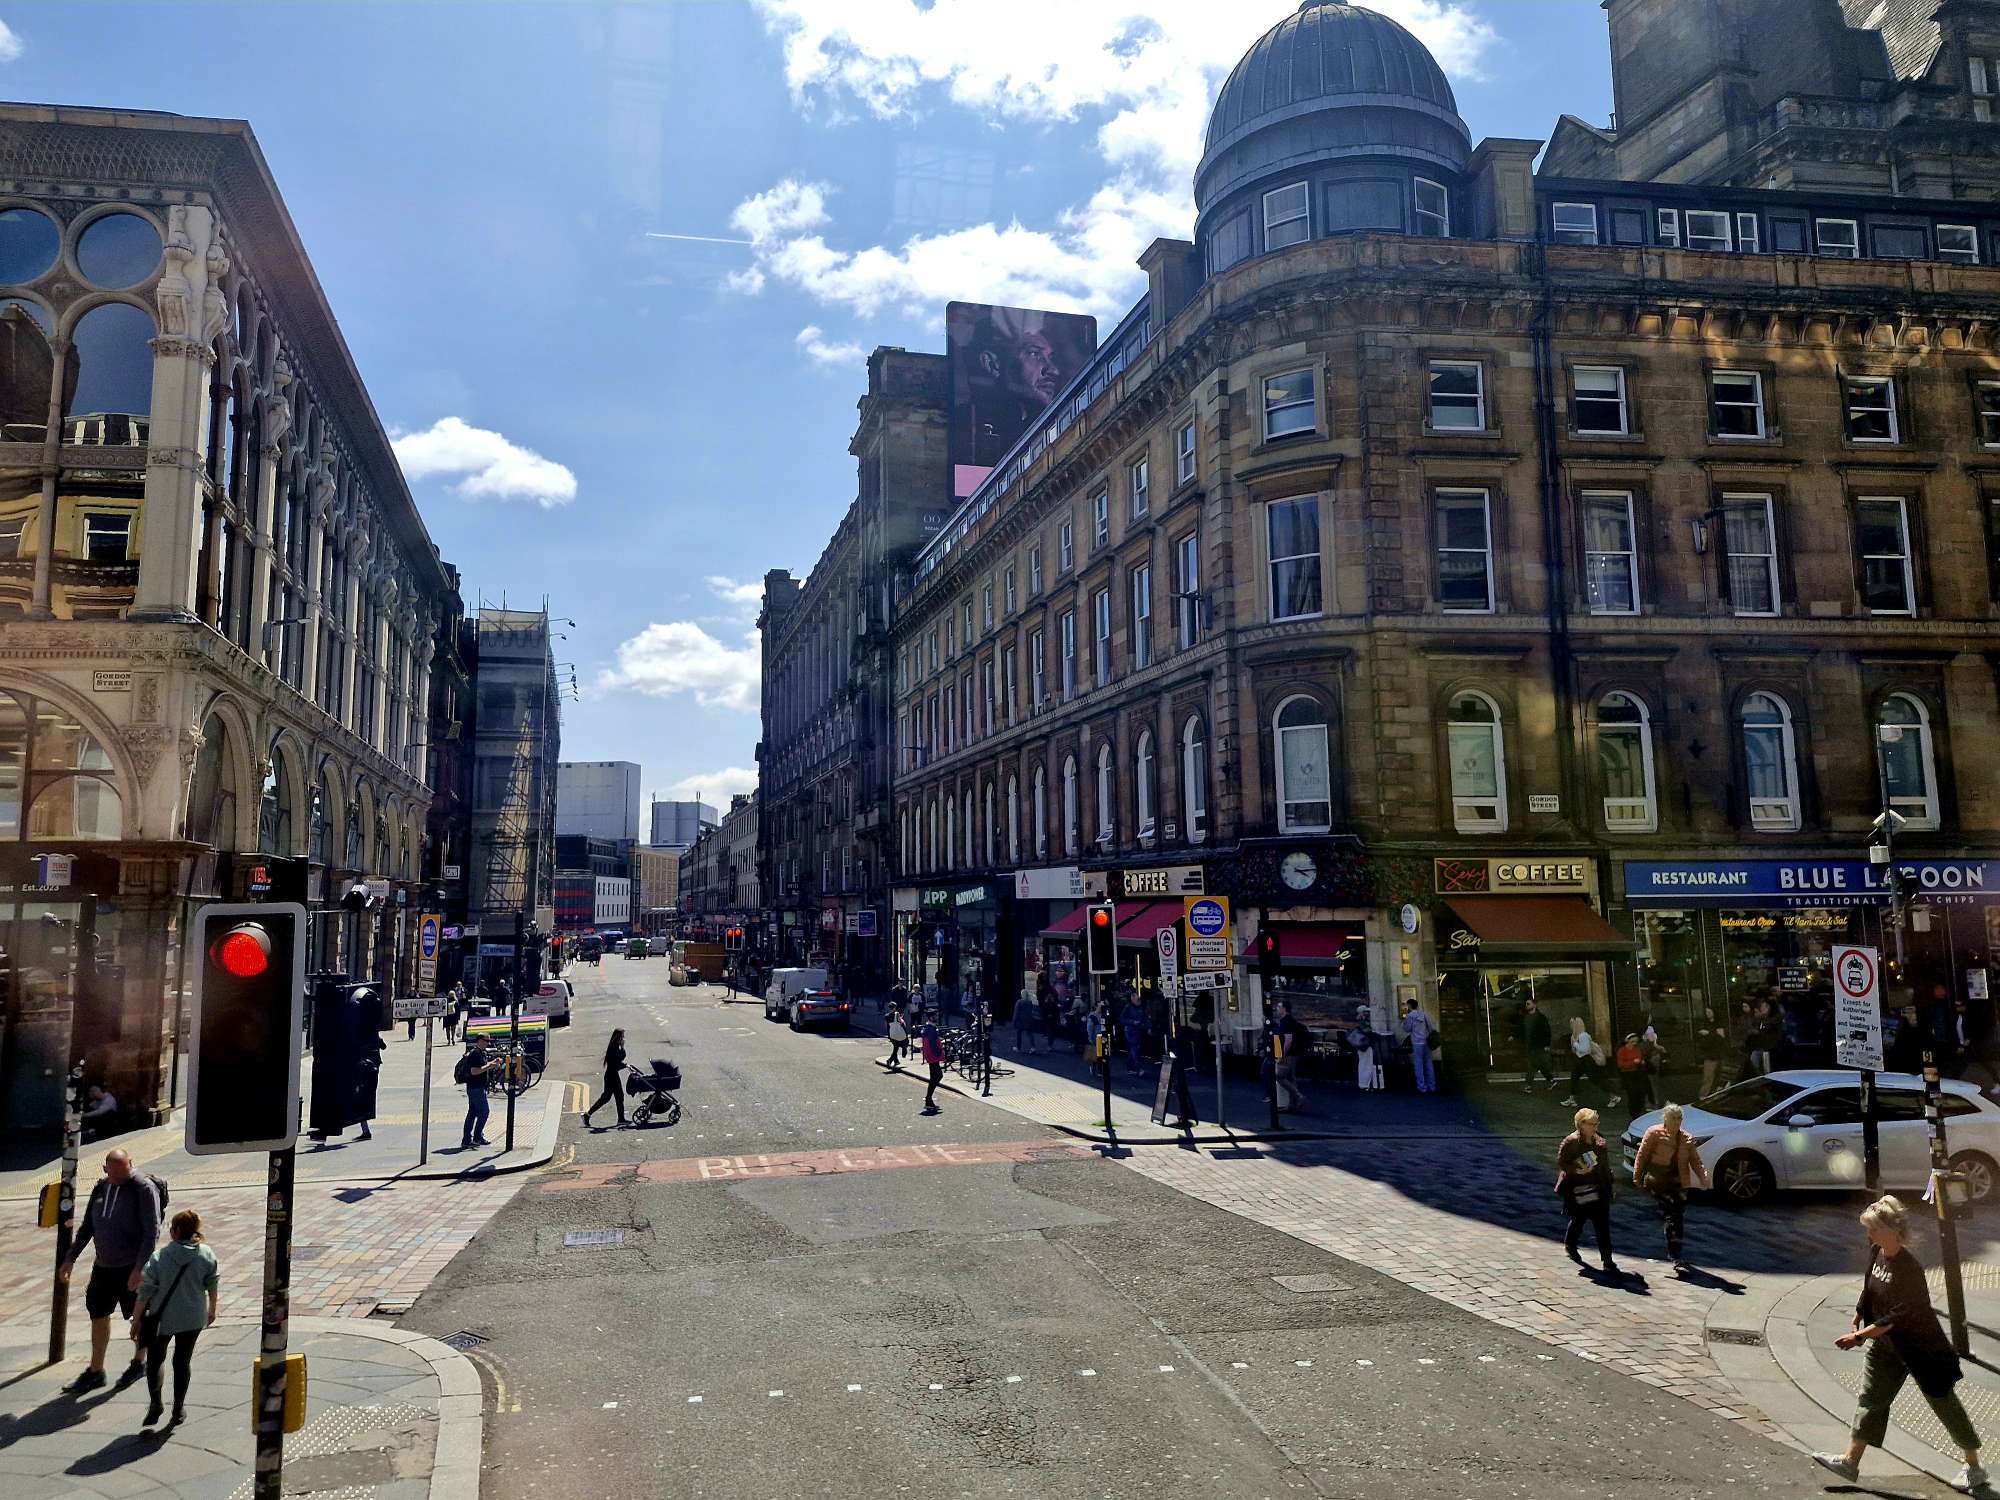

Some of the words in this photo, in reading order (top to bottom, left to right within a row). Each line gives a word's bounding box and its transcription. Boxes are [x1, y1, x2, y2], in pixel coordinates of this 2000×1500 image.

[95, 672, 131, 680] GORDON
[1497, 864, 1584, 881] COFFEE
[1651, 871, 1748, 885] RESTAURANT
[1779, 867, 1847, 889] BLUE
[1123, 871, 1169, 893] COFFEE
[1787, 897, 1877, 906] TRADITIONAL
[1936, 895, 1975, 904] CHIPS
[1720, 917, 1756, 927] estaurant
[1833, 916, 1848, 926] Sat
[1842, 998, 1861, 1007] Except
[1871, 1023, 1879, 1032] by
